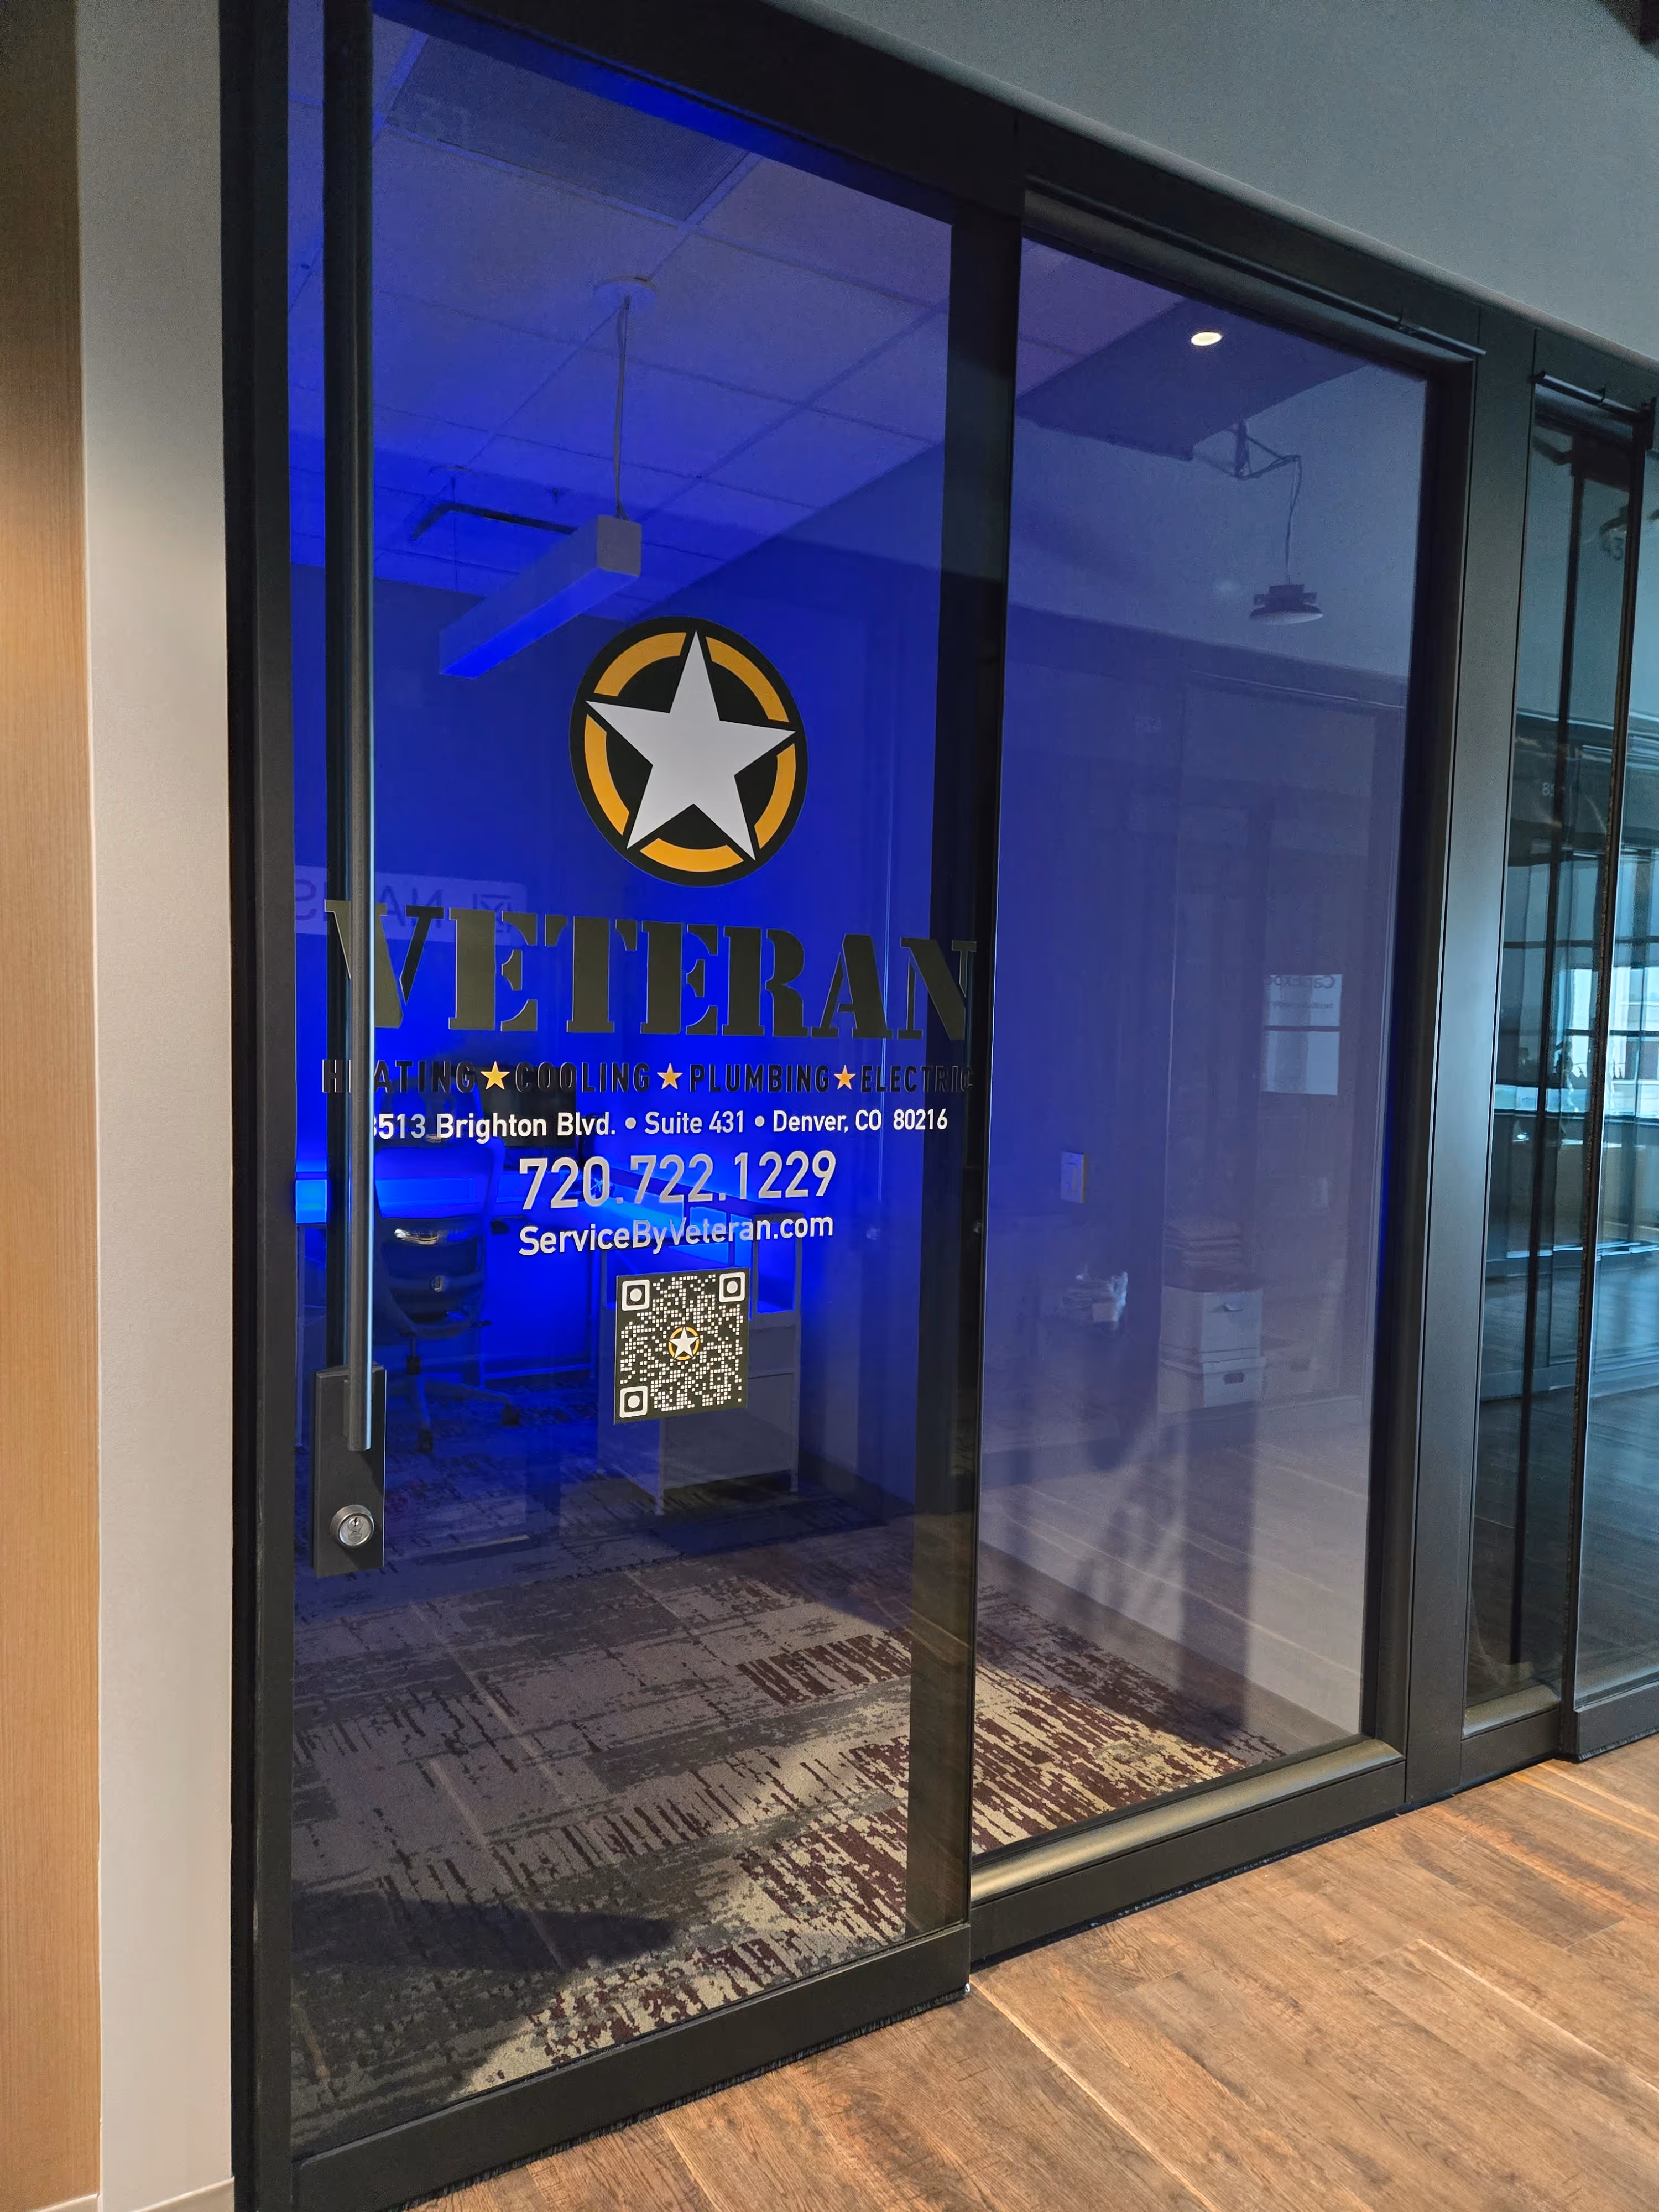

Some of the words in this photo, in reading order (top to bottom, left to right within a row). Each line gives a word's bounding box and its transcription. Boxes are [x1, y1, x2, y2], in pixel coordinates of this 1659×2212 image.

[324, 900, 977, 1041] VETERAN
[322, 1059, 476, 1093] HATING
[515, 1062, 650, 1093] COOLING
[690, 1064, 829, 1093] PLUMBING
[861, 1065, 973, 1093] ELECTRIC
[373, 1113, 426, 1139] 513
[436, 1112, 545, 1144] Brighton
[557, 1111, 615, 1137] Blvd.
[644, 1112, 702, 1134] Suite
[709, 1110, 744, 1133] 431
[773, 1110, 848, 1134] Denver,
[855, 1109, 882, 1130] CO
[893, 1109, 948, 1130] 80216
[519, 1151, 836, 1210] 720.722.1229
[519, 1217, 834, 1256] ServiceByVeteran.com
